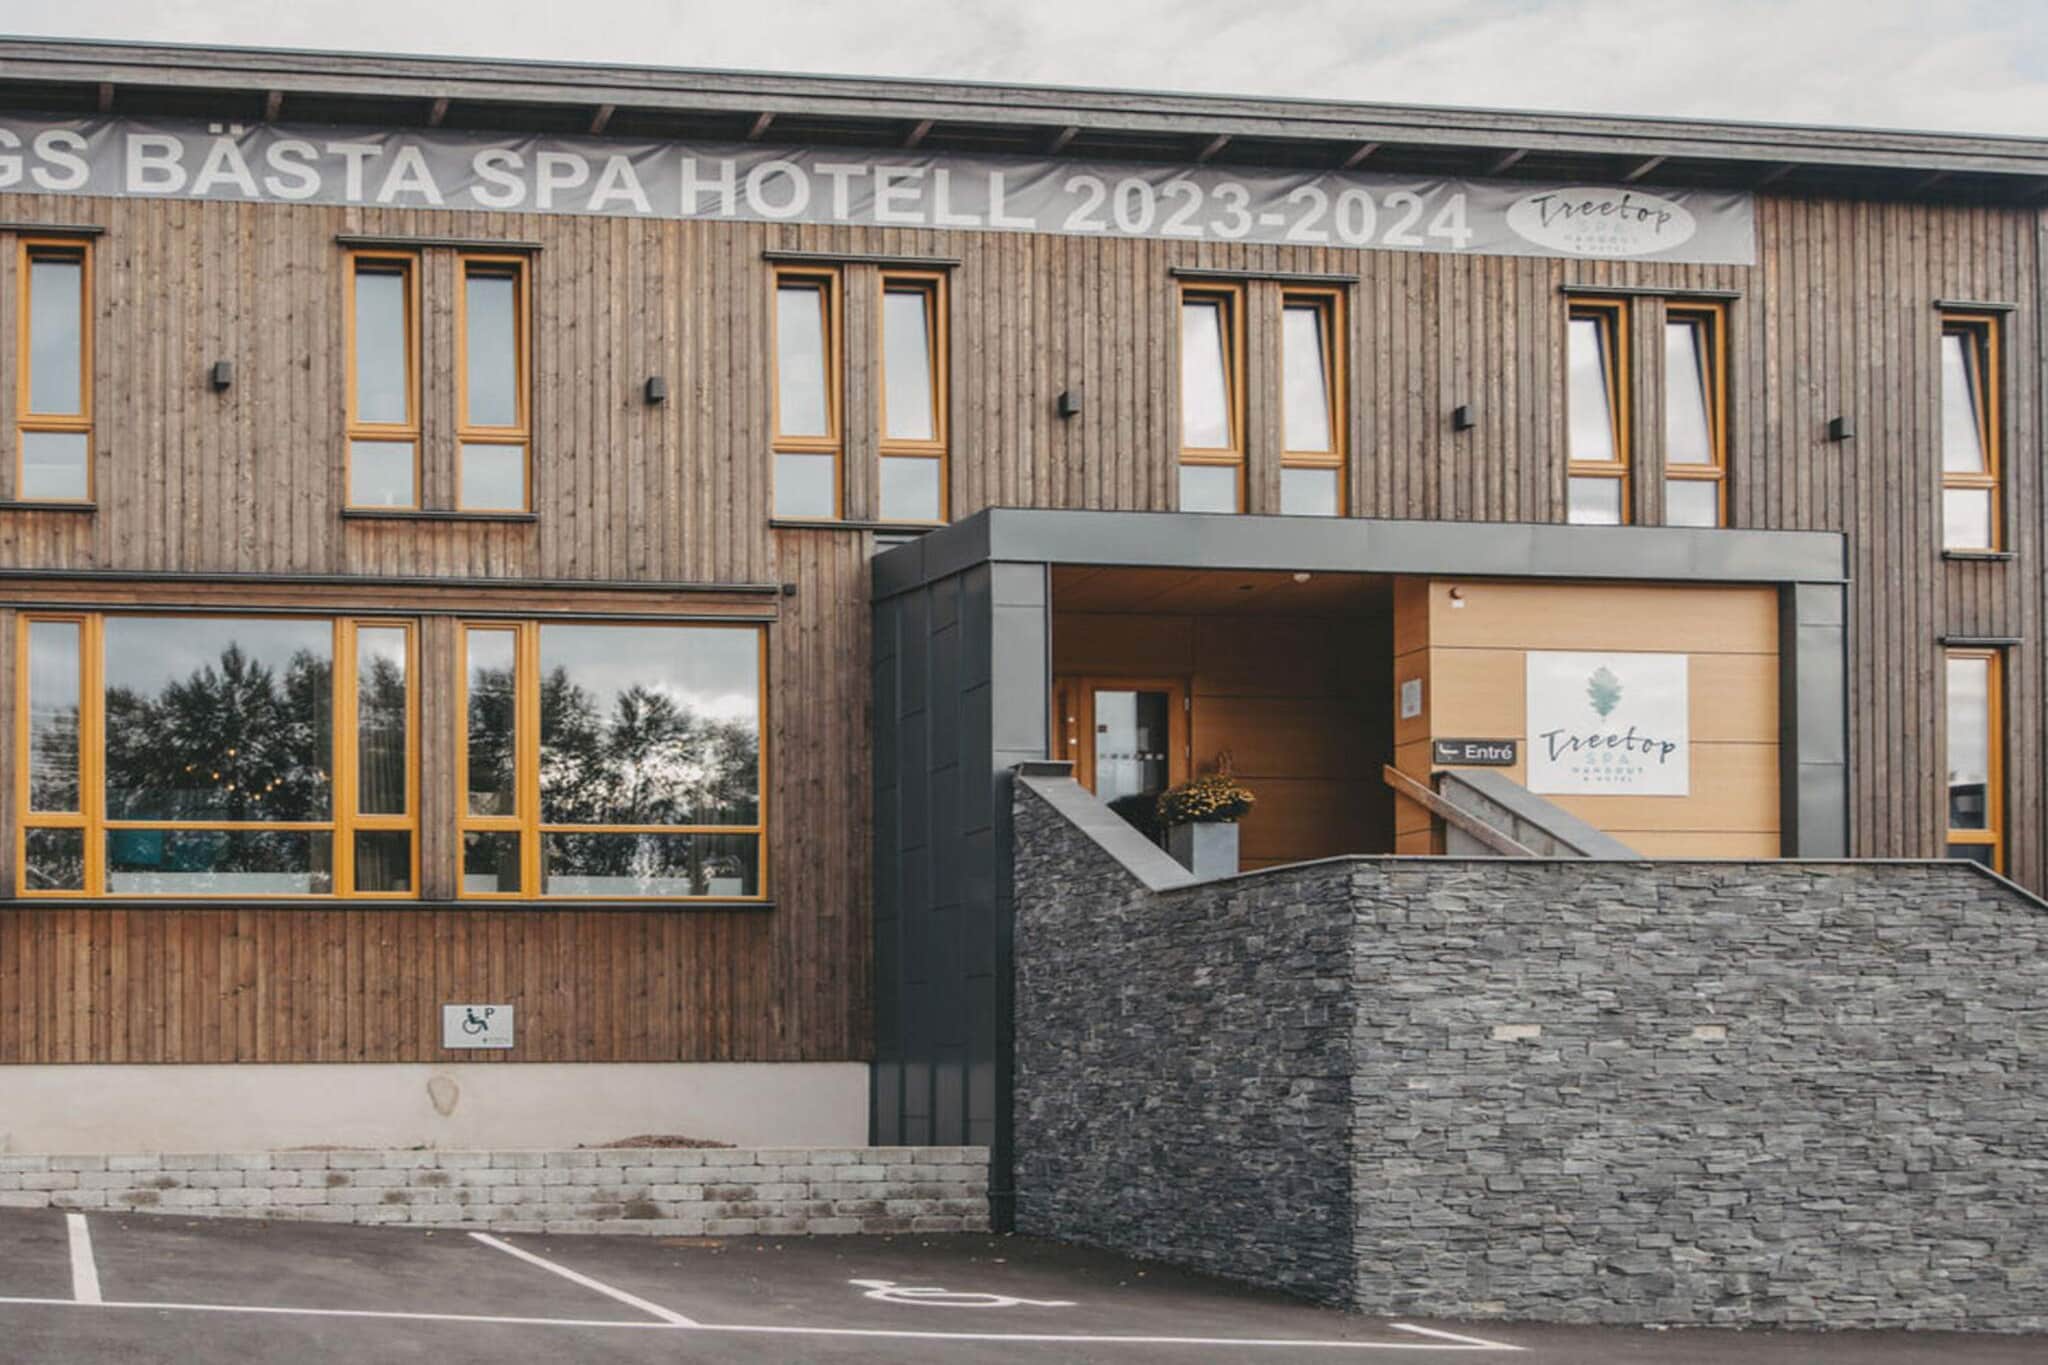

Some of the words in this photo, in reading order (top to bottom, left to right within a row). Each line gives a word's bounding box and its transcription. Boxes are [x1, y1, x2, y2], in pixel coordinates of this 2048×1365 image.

[126, 123, 443, 205] BÄSTA
[470, 149, 652, 212] SPA
[680, 157, 1036, 229] HOTELL
[1062, 174, 1473, 249] 2023-2024
[1530, 193, 1672, 235] Treetop
[1465, 744, 1512, 760] Entré
[1540, 725, 1677, 764] Treetop
